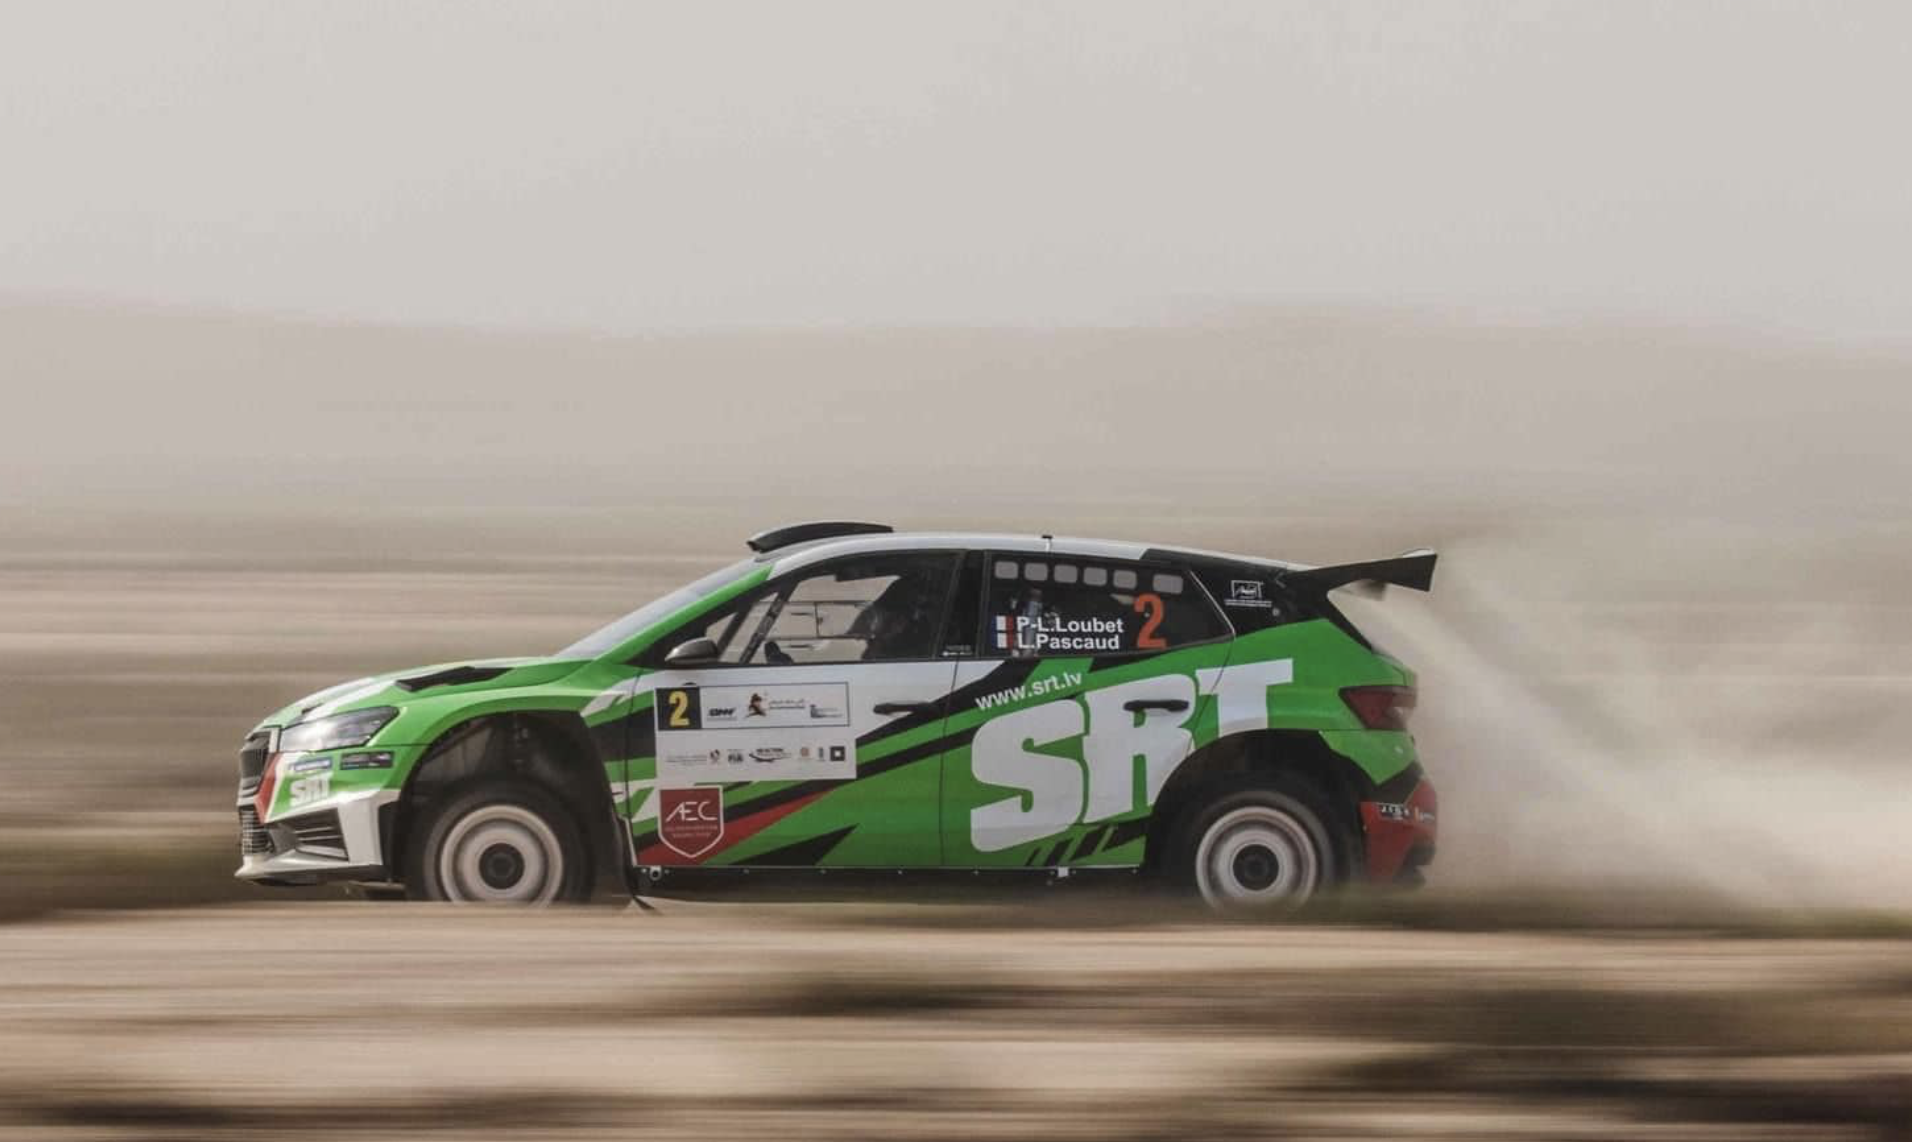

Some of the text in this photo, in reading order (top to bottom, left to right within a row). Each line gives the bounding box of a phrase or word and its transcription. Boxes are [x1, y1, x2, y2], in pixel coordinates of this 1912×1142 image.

[1016, 616, 1124, 633] P-L.Loubet
[1133, 593, 1168, 649] 2
[1017, 633, 1119, 649] L.Pascaud
[668, 690, 690, 727] 2
[975, 672, 1082, 710] www.srt.lv
[971, 658, 1293, 852] SRT
